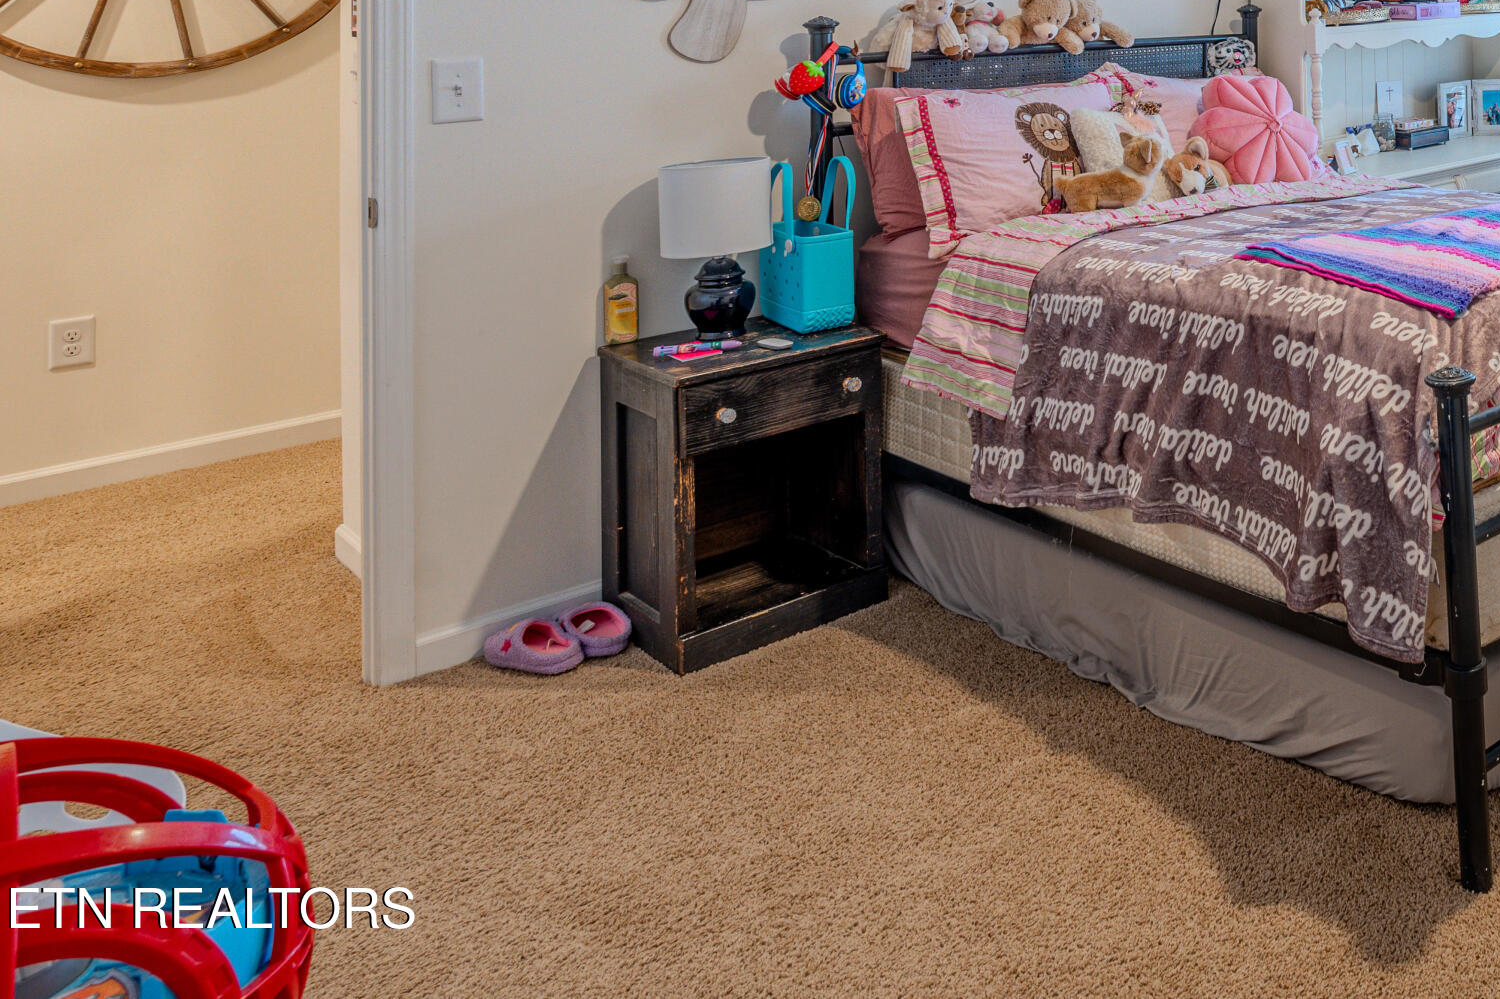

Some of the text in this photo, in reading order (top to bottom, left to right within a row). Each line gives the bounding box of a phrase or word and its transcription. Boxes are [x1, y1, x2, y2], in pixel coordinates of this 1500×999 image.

[1075, 256, 1127, 276] irene
[1041, 293, 1103, 328] delilah
[1128, 300, 1175, 340] irene
[1182, 370, 1238, 415] irene
[1322, 353, 1411, 417] delilah
[1031, 396, 1095, 435] delilah
[1320, 423, 1384, 483] irene
[1172, 482, 1231, 532] irene
[1235, 505, 1297, 569] delilah
